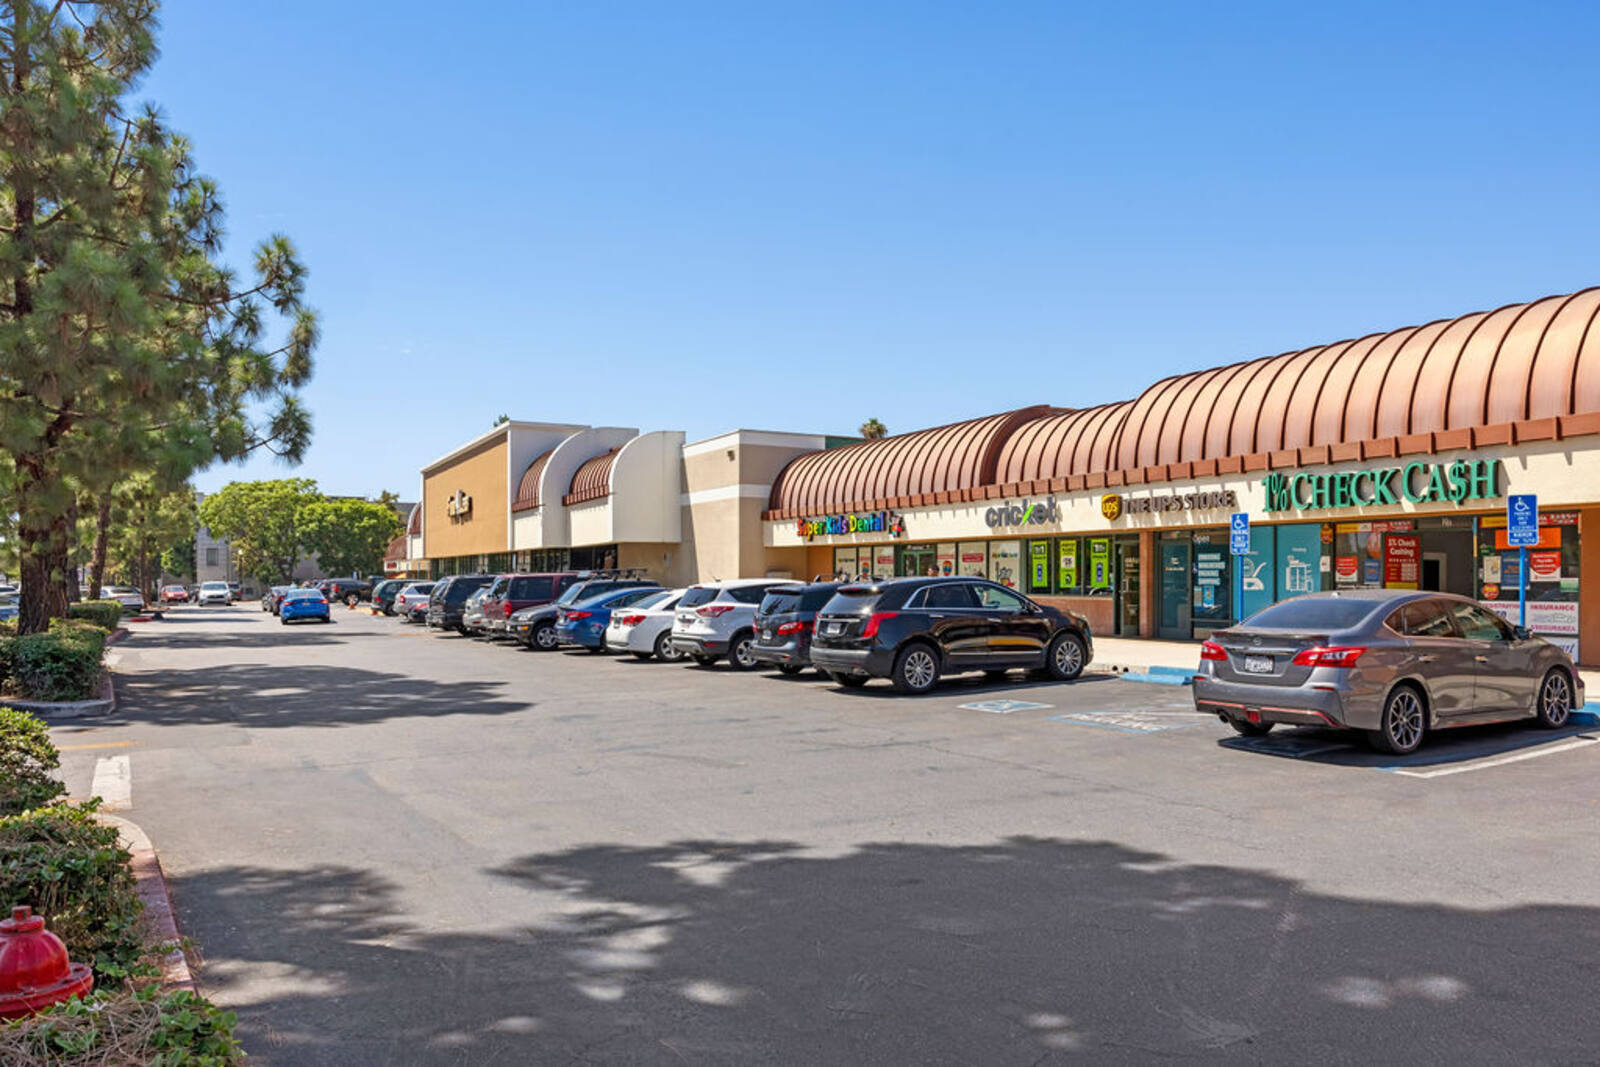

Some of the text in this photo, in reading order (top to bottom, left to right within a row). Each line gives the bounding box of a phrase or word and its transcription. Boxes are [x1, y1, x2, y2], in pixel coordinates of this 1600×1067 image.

[1262, 459, 1499, 512] 1% CHECK CA$H
[985, 496, 1057, 528] cricket
[1123, 490, 1236, 514] THE UPS STORE
[797, 512, 886, 541] Super Kids Dental
[1398, 538, 1416, 547] Check
[1530, 603, 1576, 611] INSURANCE
